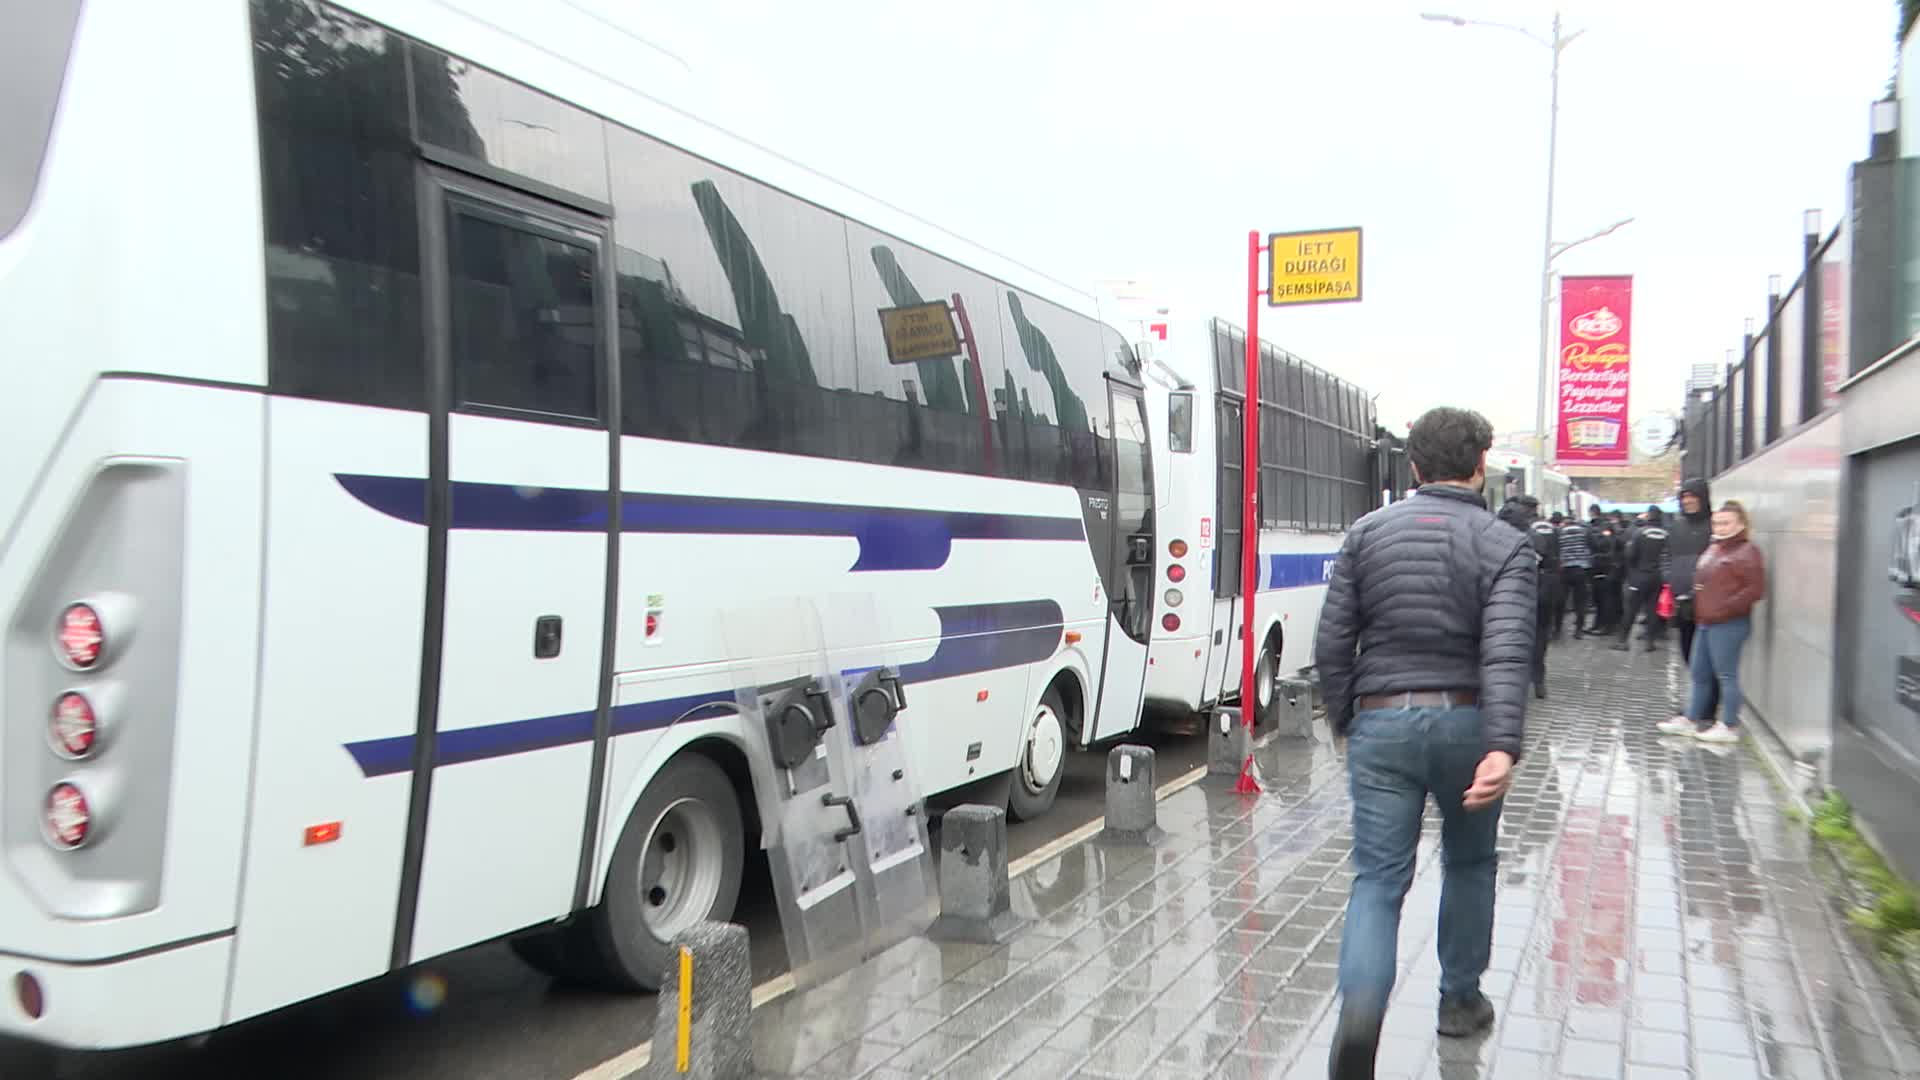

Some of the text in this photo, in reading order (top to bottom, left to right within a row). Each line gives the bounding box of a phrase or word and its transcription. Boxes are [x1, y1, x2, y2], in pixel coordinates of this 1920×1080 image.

[1298, 239, 1335, 256] İETT
[1285, 256, 1346, 273] DURAĞI
[1278, 280, 1352, 298] ŞEMSİPAŞA
